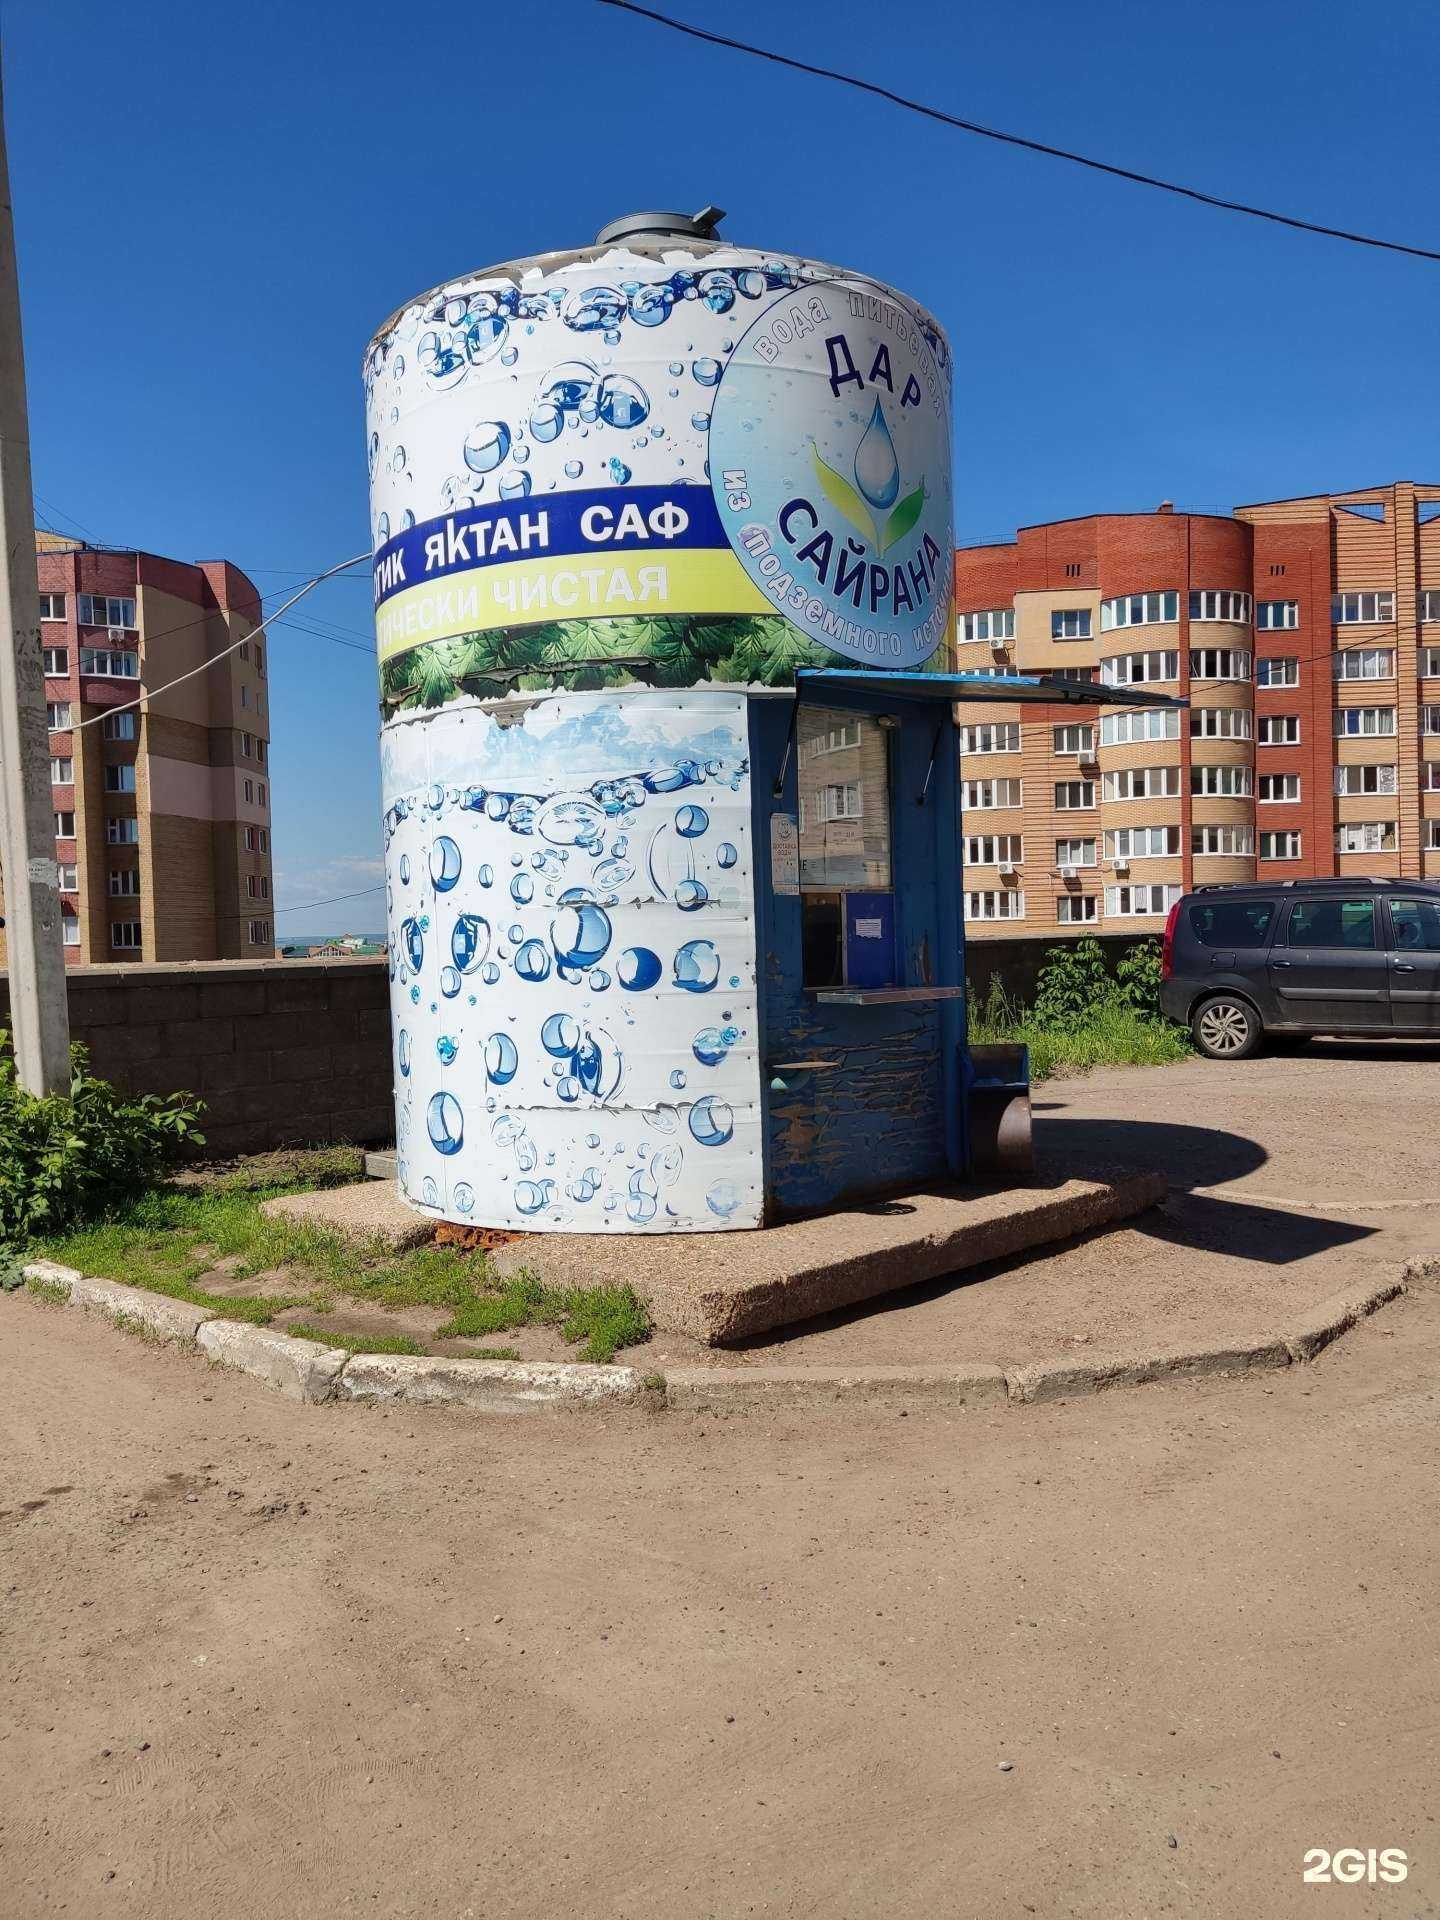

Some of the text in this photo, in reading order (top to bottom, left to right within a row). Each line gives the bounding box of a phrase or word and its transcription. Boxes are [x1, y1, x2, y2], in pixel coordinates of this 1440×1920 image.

[825, 334, 921, 407] ДАР
[580, 501, 690, 542] САФ
[778, 498, 941, 616] САЙРАНА
[492, 565, 669, 613] ЧИСТАЯ
